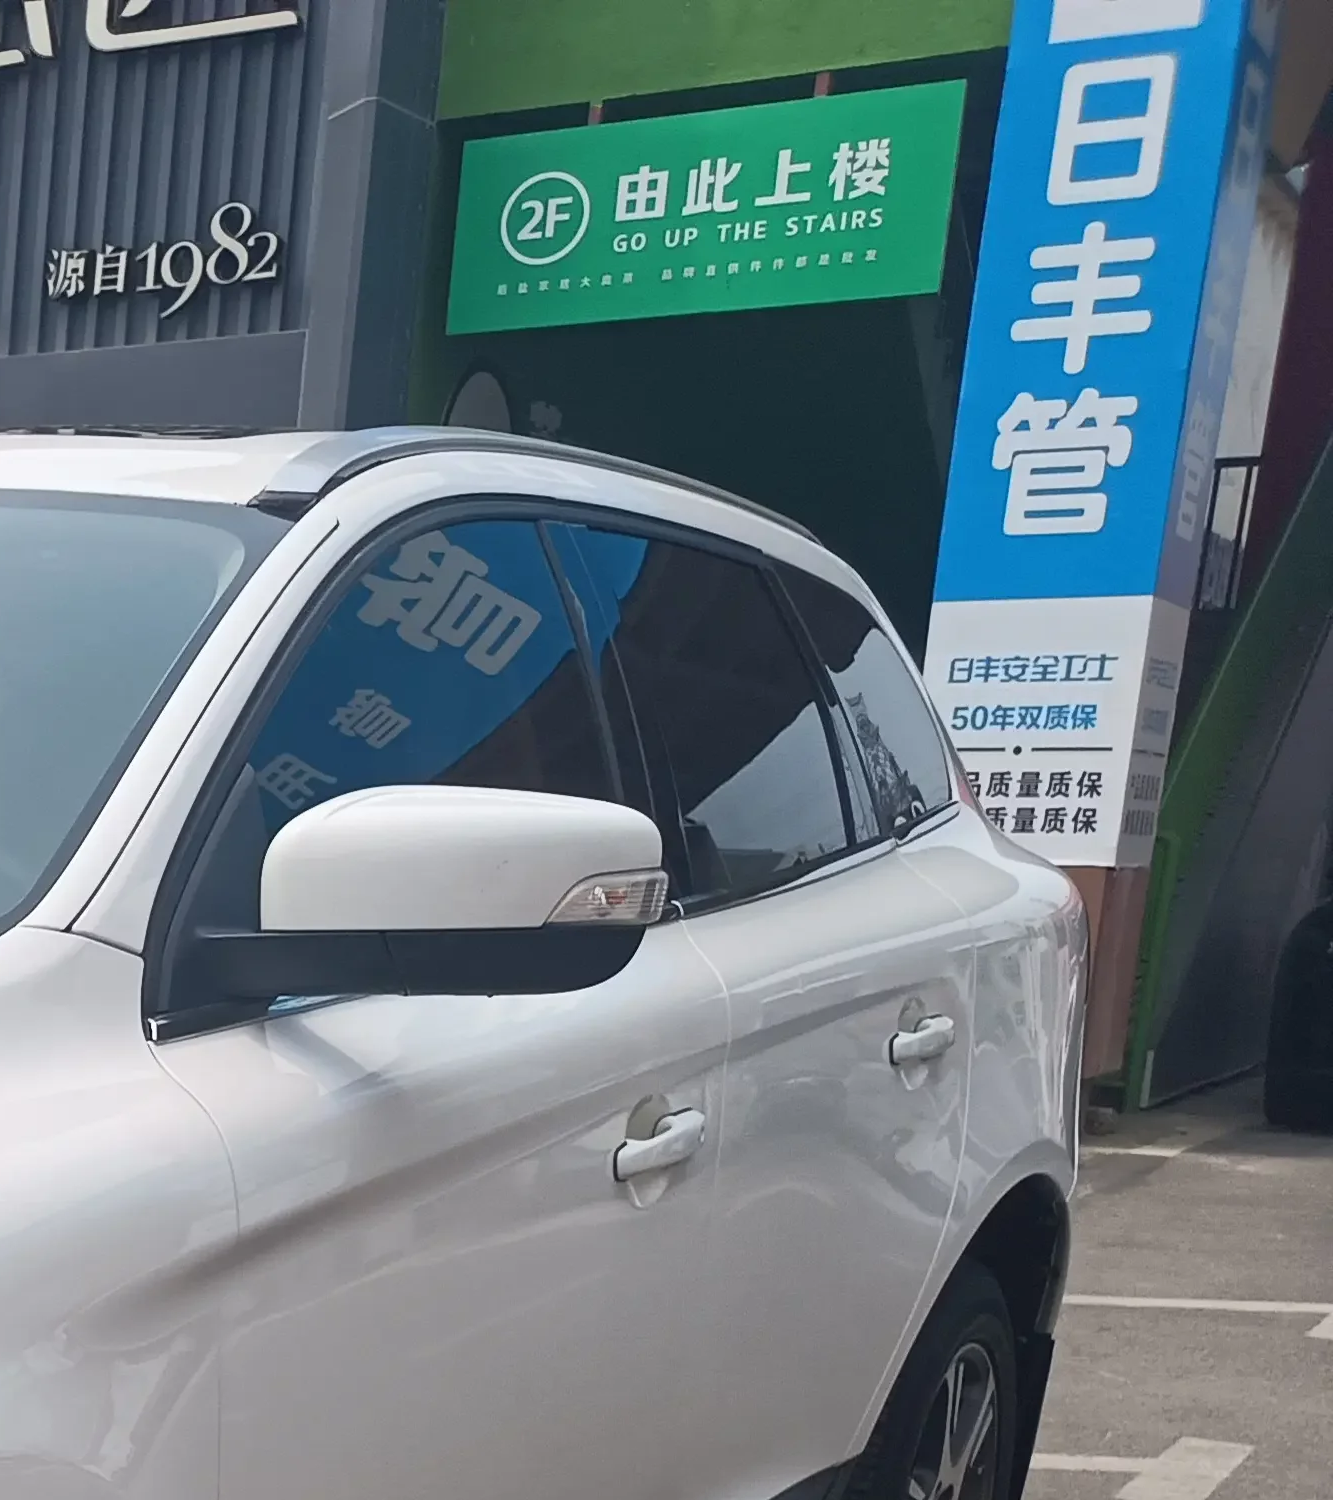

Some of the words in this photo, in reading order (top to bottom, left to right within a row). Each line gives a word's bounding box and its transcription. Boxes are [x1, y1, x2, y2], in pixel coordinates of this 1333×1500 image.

[614, 137, 891, 223] 由此上楼
[517, 196, 573, 241] 2F
[612, 233, 647, 254] GO
[664, 225, 699, 249] UP
[717, 220, 768, 244] THE
[785, 207, 884, 237] STAIRS
[46, 201, 278, 318] 源自1982
[992, 54, 1176, 536] 日丰管
[947, 653, 1120, 684] 日丰安全卫士
[950, 704, 1098, 731] 50年双质保
